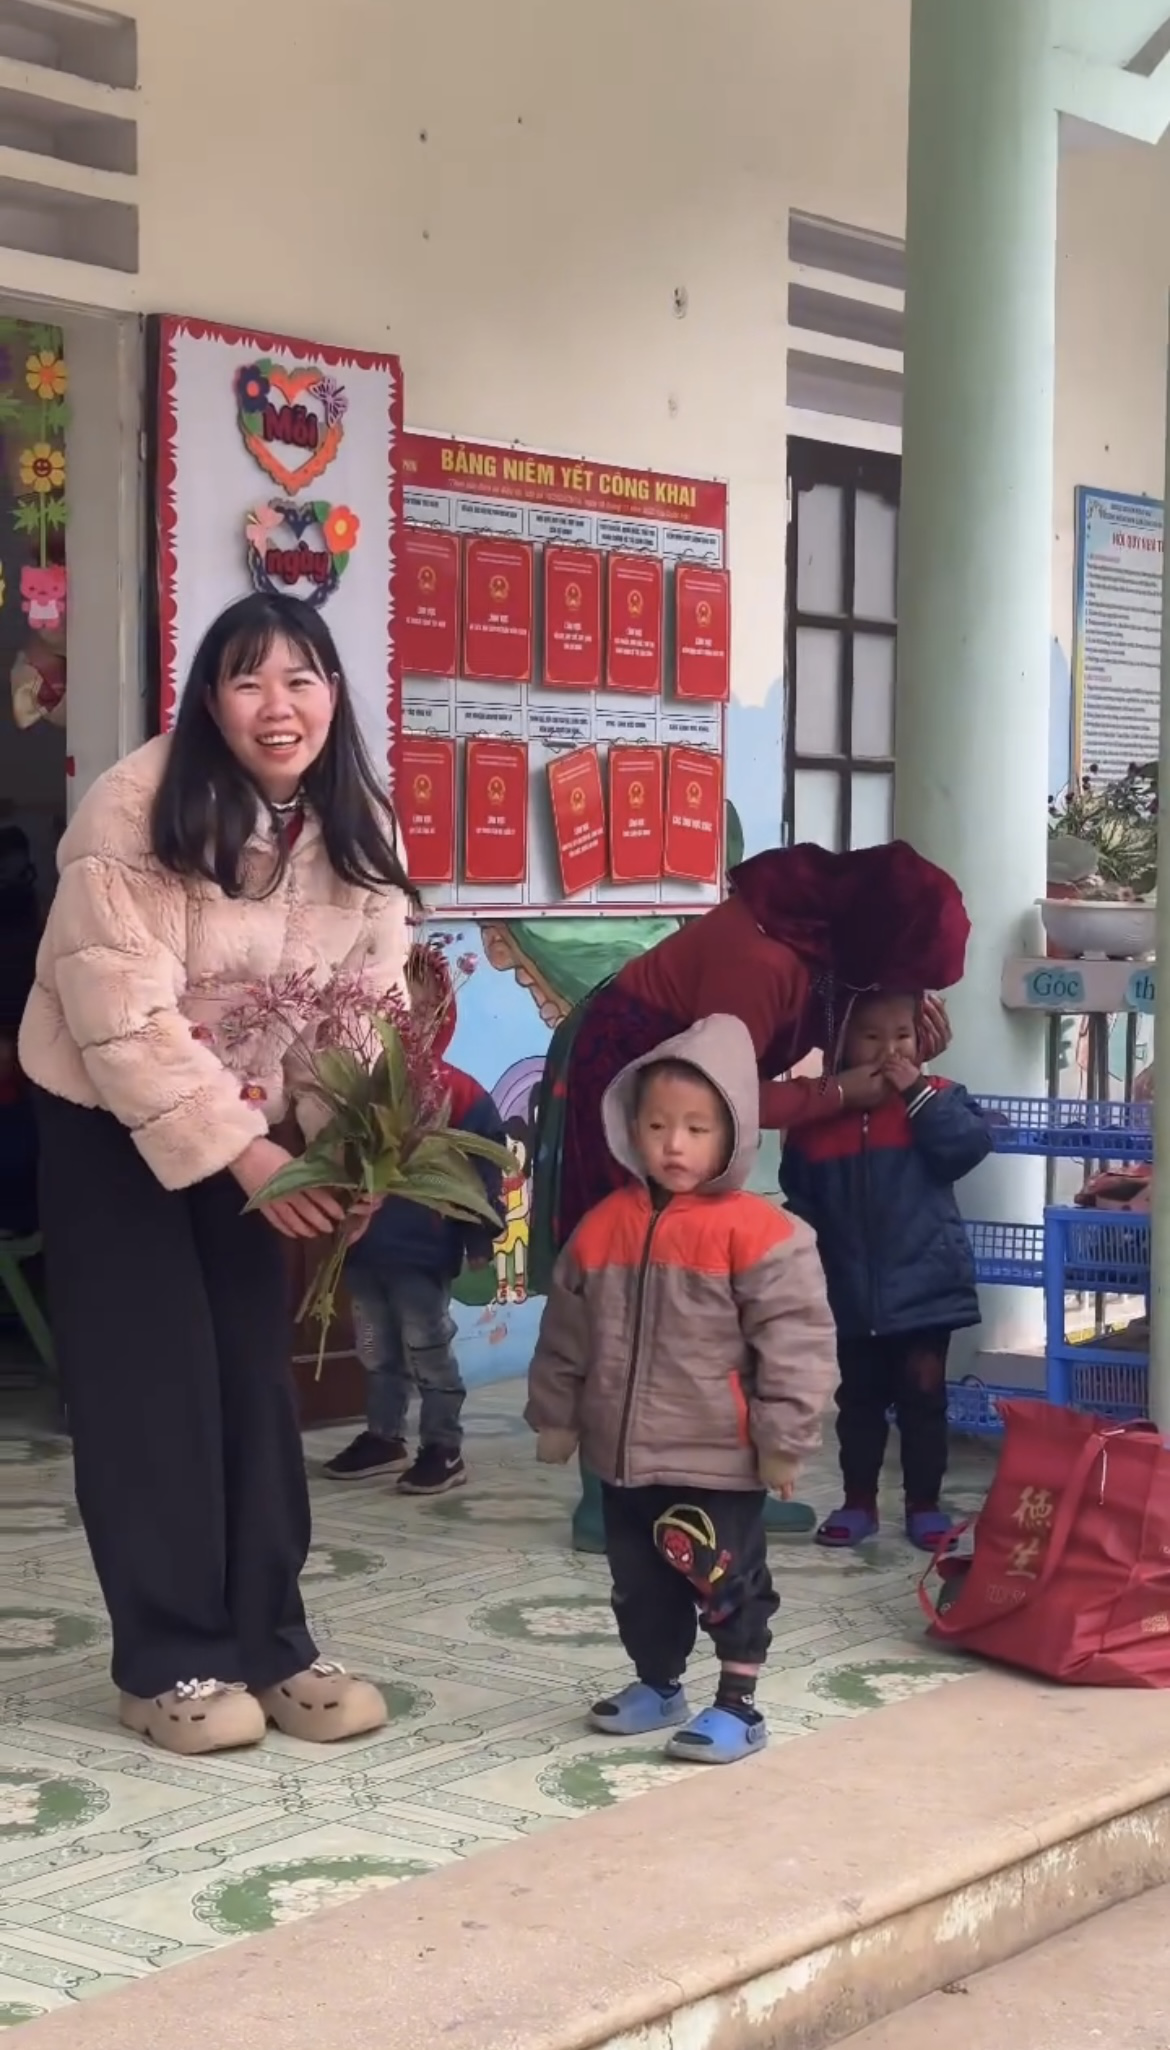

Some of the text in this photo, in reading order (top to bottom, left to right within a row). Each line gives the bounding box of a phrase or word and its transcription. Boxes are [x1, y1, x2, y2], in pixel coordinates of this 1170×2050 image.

[263, 402, 319, 449] Mỗi
[441, 444, 497, 478] BẢNG
[503, 457, 555, 486] NIÊM
[560, 462, 593, 492] YẾT
[599, 471, 649, 500] CÔNG
[655, 481, 697, 508] KHAI
[265, 540, 330, 585] ngày
[1033, 972, 1079, 997] Góc
